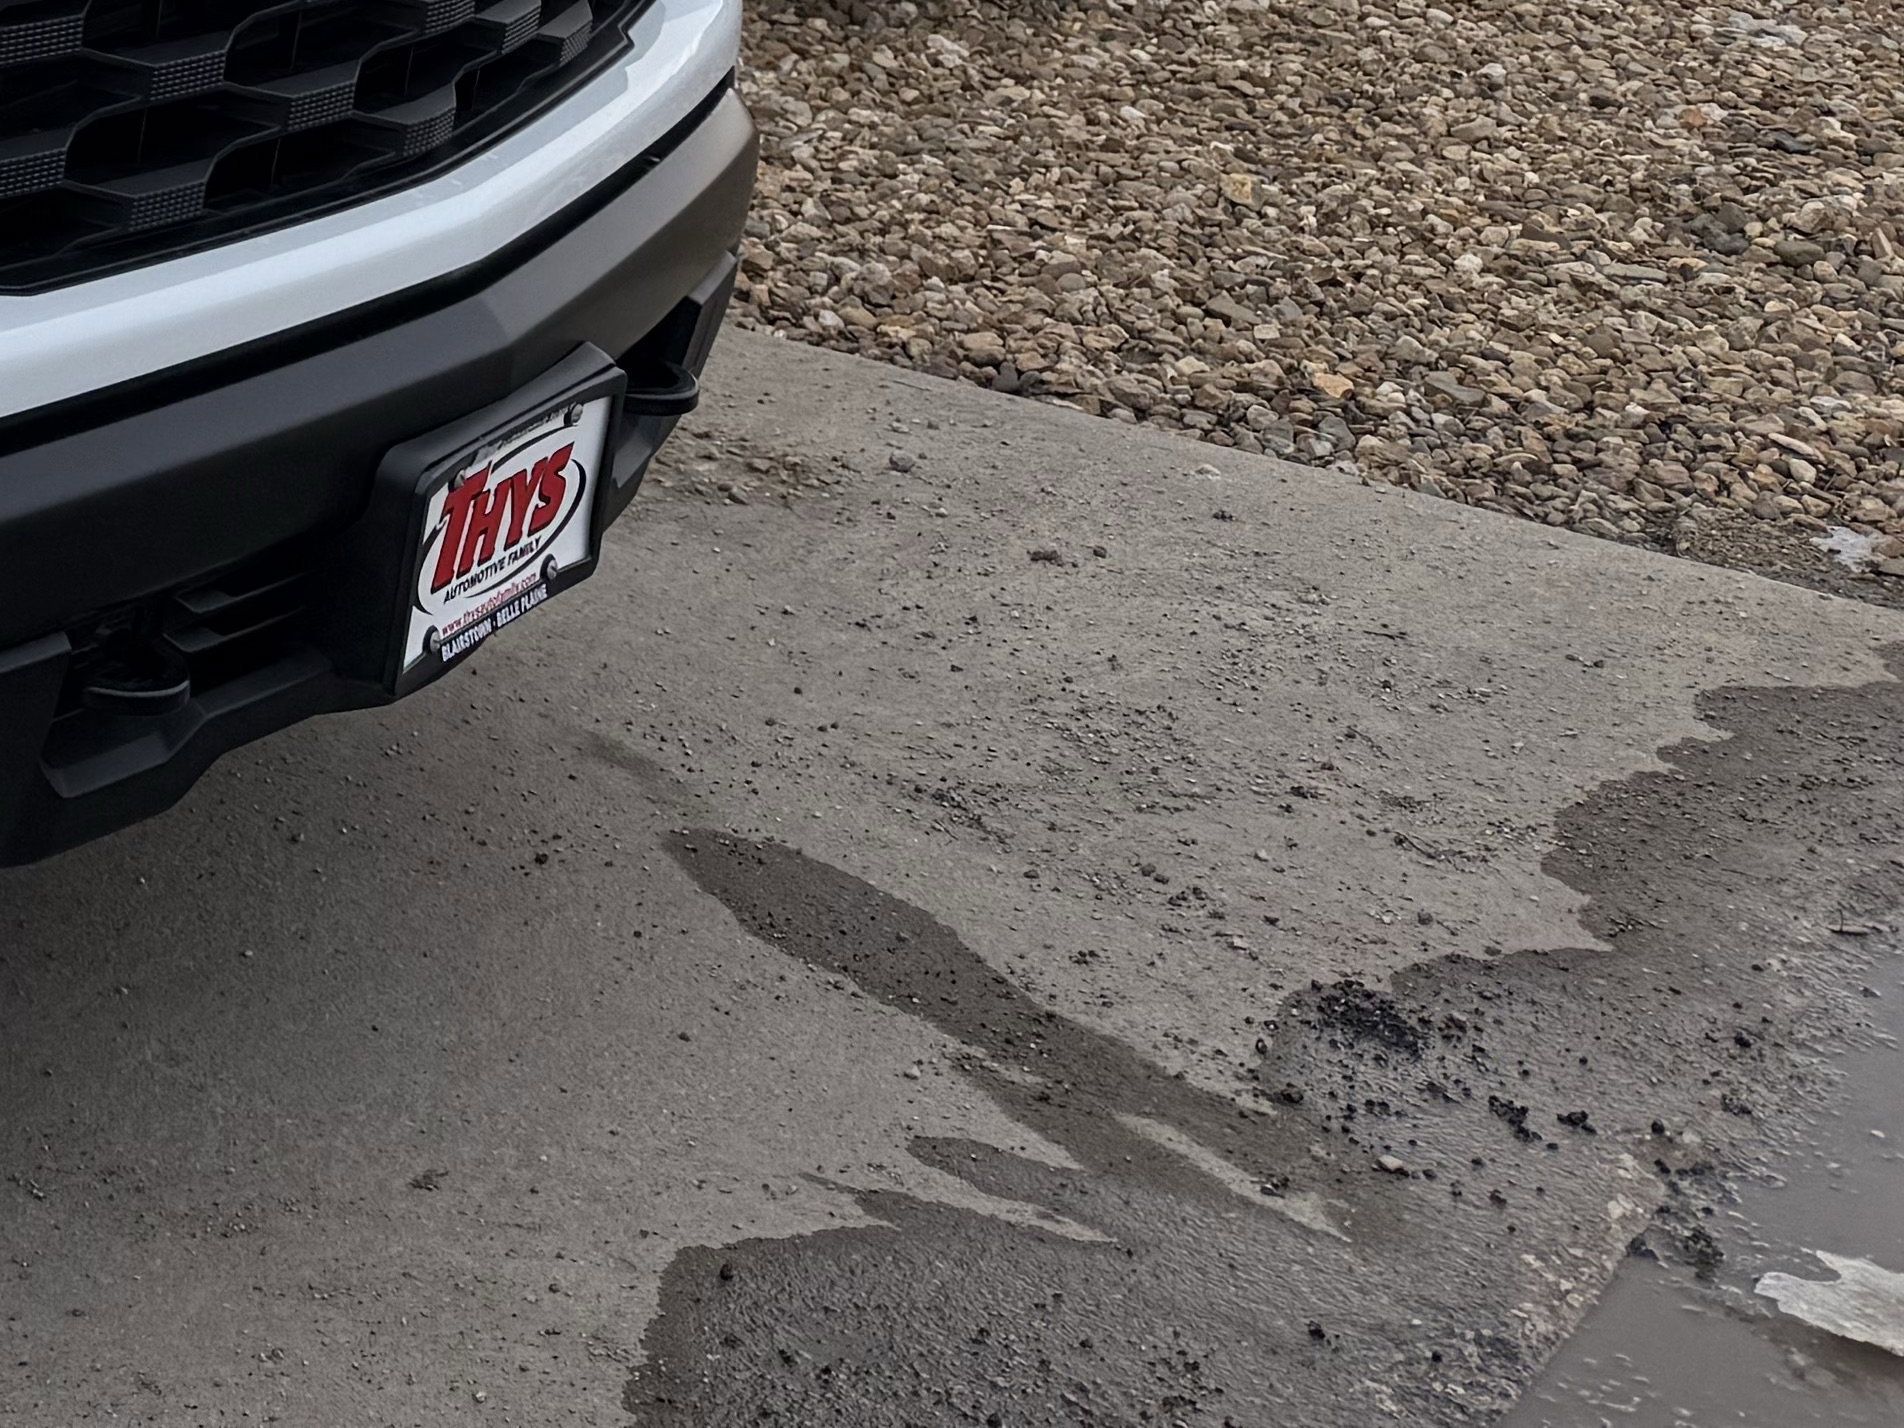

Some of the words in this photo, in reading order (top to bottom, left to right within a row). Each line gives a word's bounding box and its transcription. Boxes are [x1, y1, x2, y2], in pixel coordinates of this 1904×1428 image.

[430, 440, 575, 595] THYS
[441, 572, 537, 636] www.thysautofamily.com
[444, 555, 506, 604] AUTOMOTIVE
[507, 535, 542, 566] FAMILY
[441, 618, 492, 662] BLAIRSTOWN
[496, 599, 521, 628] BELLE
[521, 583, 548, 614] PLAINE
